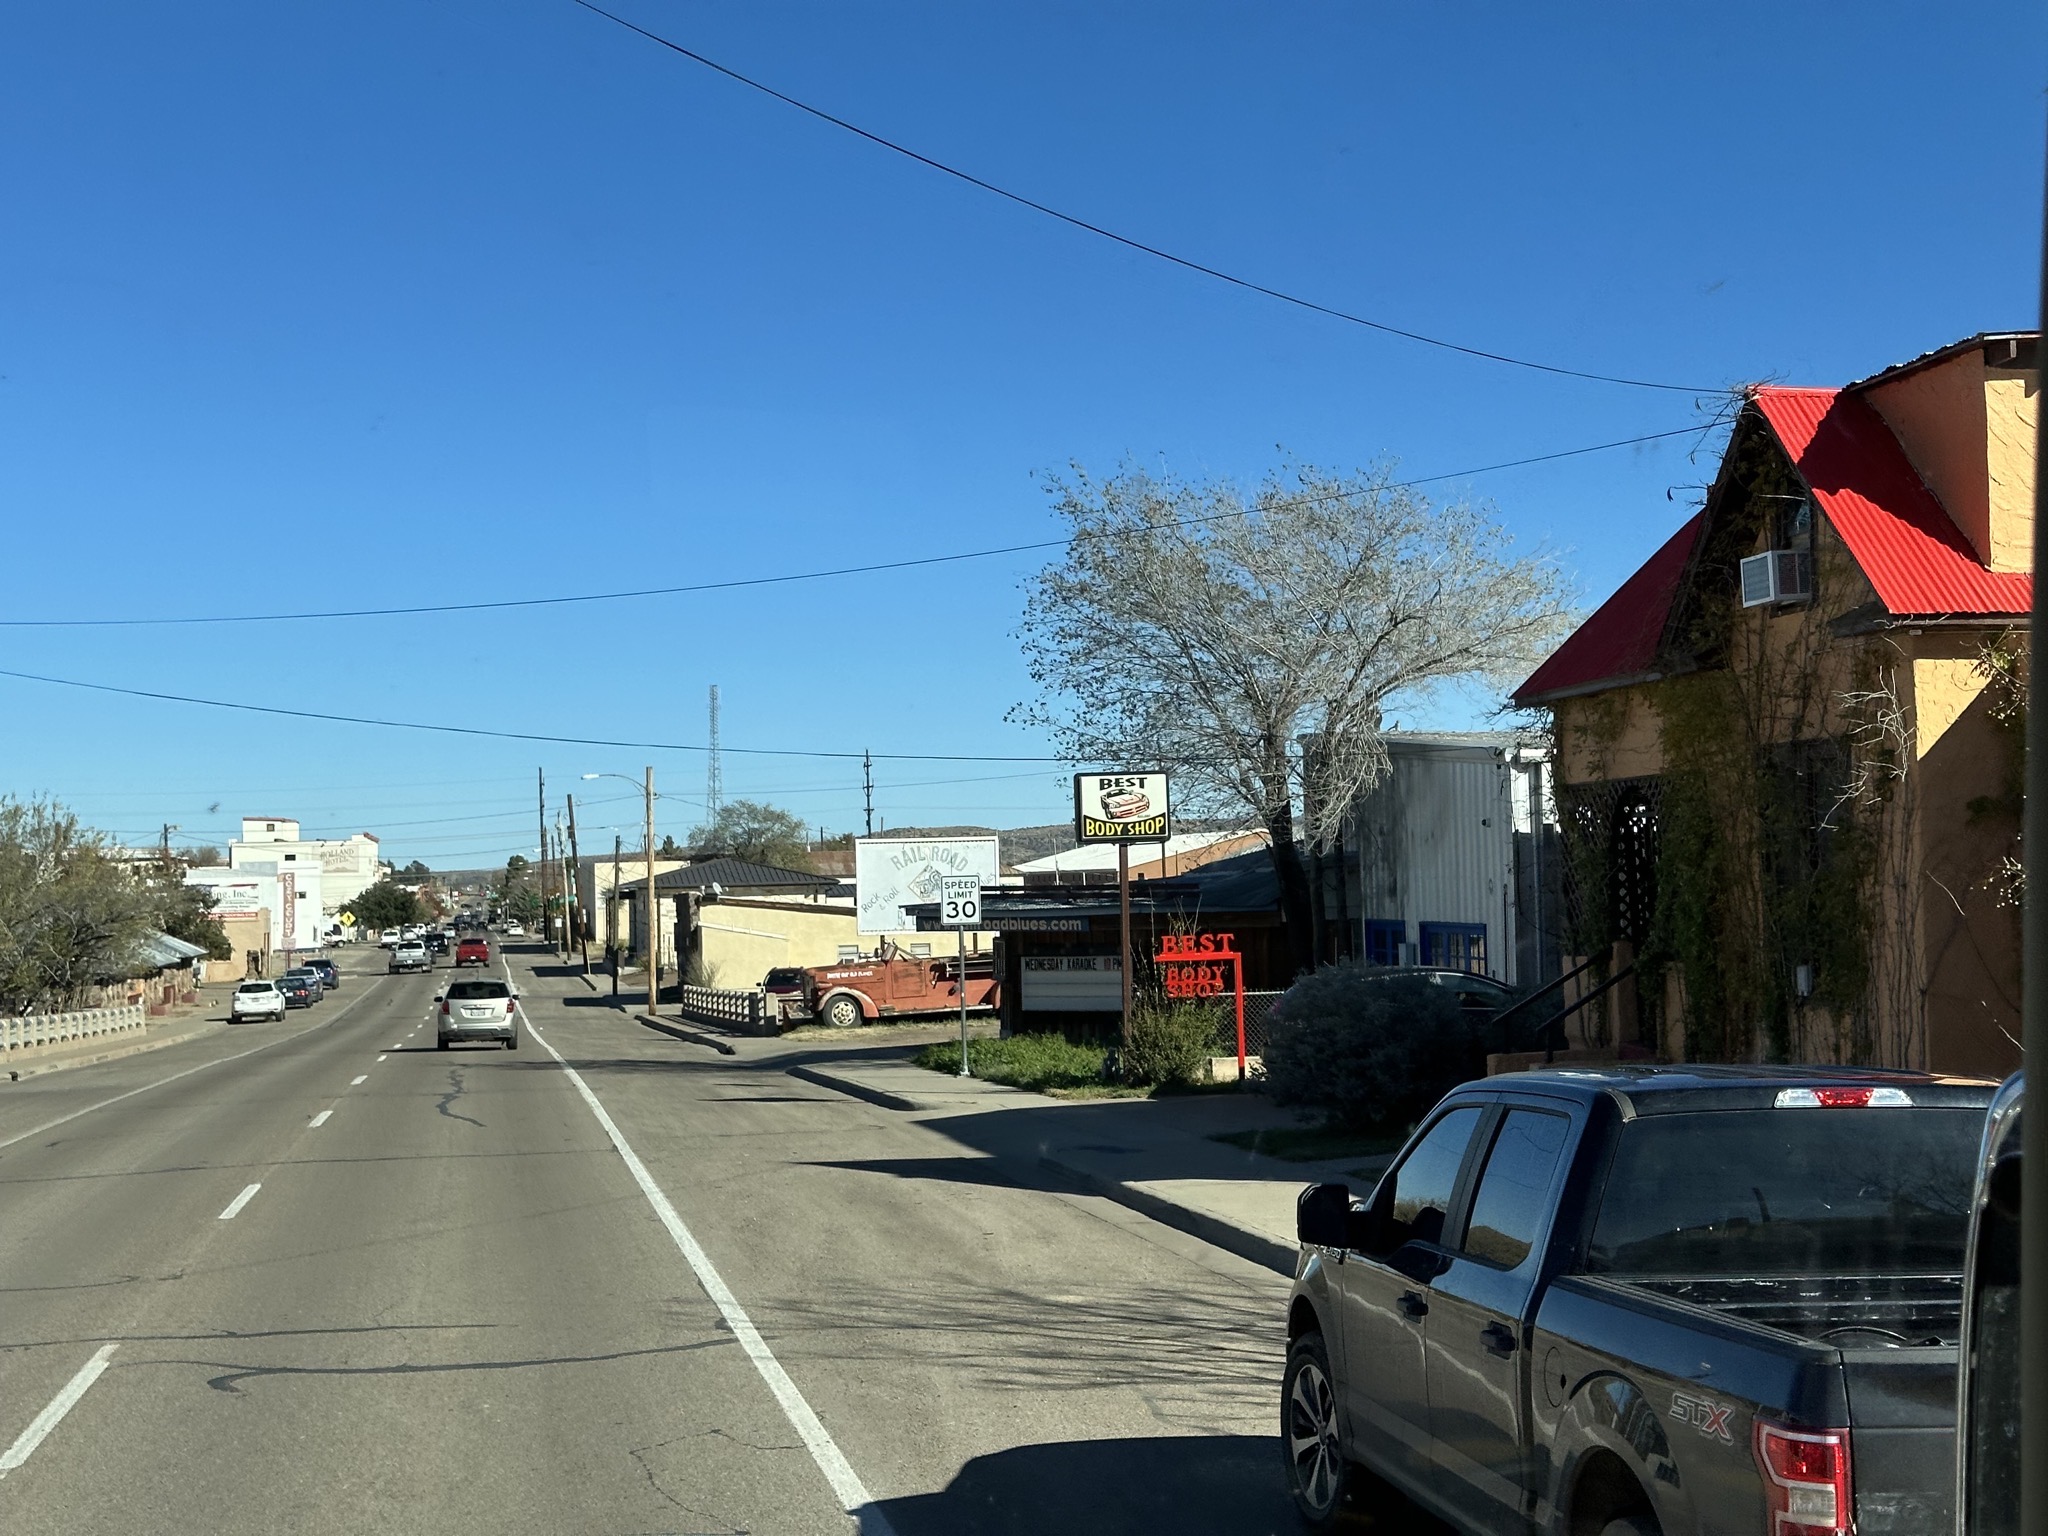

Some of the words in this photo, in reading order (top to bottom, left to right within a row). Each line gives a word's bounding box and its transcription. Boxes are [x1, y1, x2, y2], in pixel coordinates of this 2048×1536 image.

[1099, 777, 1148, 791] BEST
[1085, 818, 1124, 836] BODY
[1127, 816, 1164, 835] SHOP
[944, 881, 977, 890] SPEED
[947, 890, 973, 899] LIMIT
[861, 891, 881, 914] Rock
[884, 886, 900, 906] Roll
[946, 900, 977, 918] 30
[1161, 933, 1235, 953] BEST
[1024, 957, 1063, 971] WEDNESDAY
[1067, 957, 1097, 970] KARAOKE
[1166, 966, 1225, 983] BODY
[1166, 978, 1224, 998] SHOP
[1668, 1391, 1736, 1446] STX
